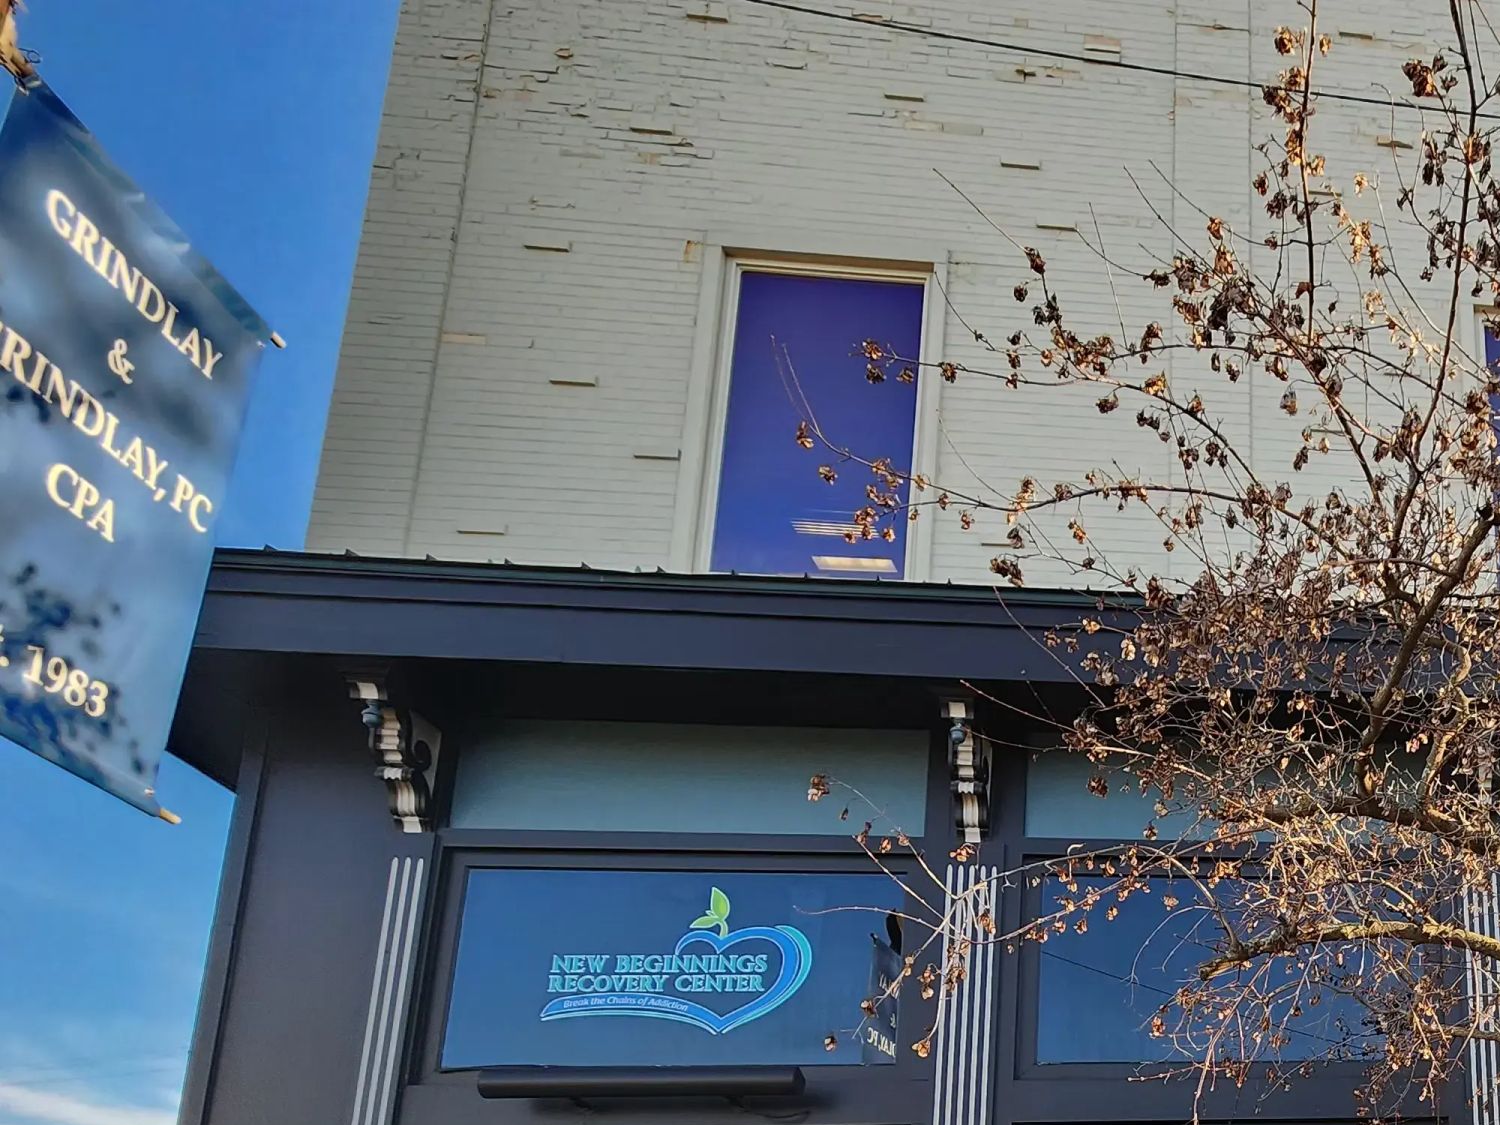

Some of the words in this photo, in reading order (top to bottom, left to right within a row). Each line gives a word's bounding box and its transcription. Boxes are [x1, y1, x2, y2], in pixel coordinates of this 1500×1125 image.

[46, 189, 223, 379] GRINDLAY
[107, 338, 135, 384] &
[0, 320, 168, 501] RINDLAY,
[170, 474, 212, 532] PC
[46, 463, 115, 543] CPA
[22, 644, 108, 718] 1983
[547, 974, 670, 993] RECOVERY
[674, 974, 765, 993] CENTER
[550, 954, 610, 973] NEW
[614, 953, 768, 973] BEGINNINGS
[563, 999, 588, 1009] Break
[590, 997, 605, 1006] the
[606, 996, 636, 1005] Chains
[637, 996, 648, 1007] of
[647, 998, 689, 1012] Addiction
